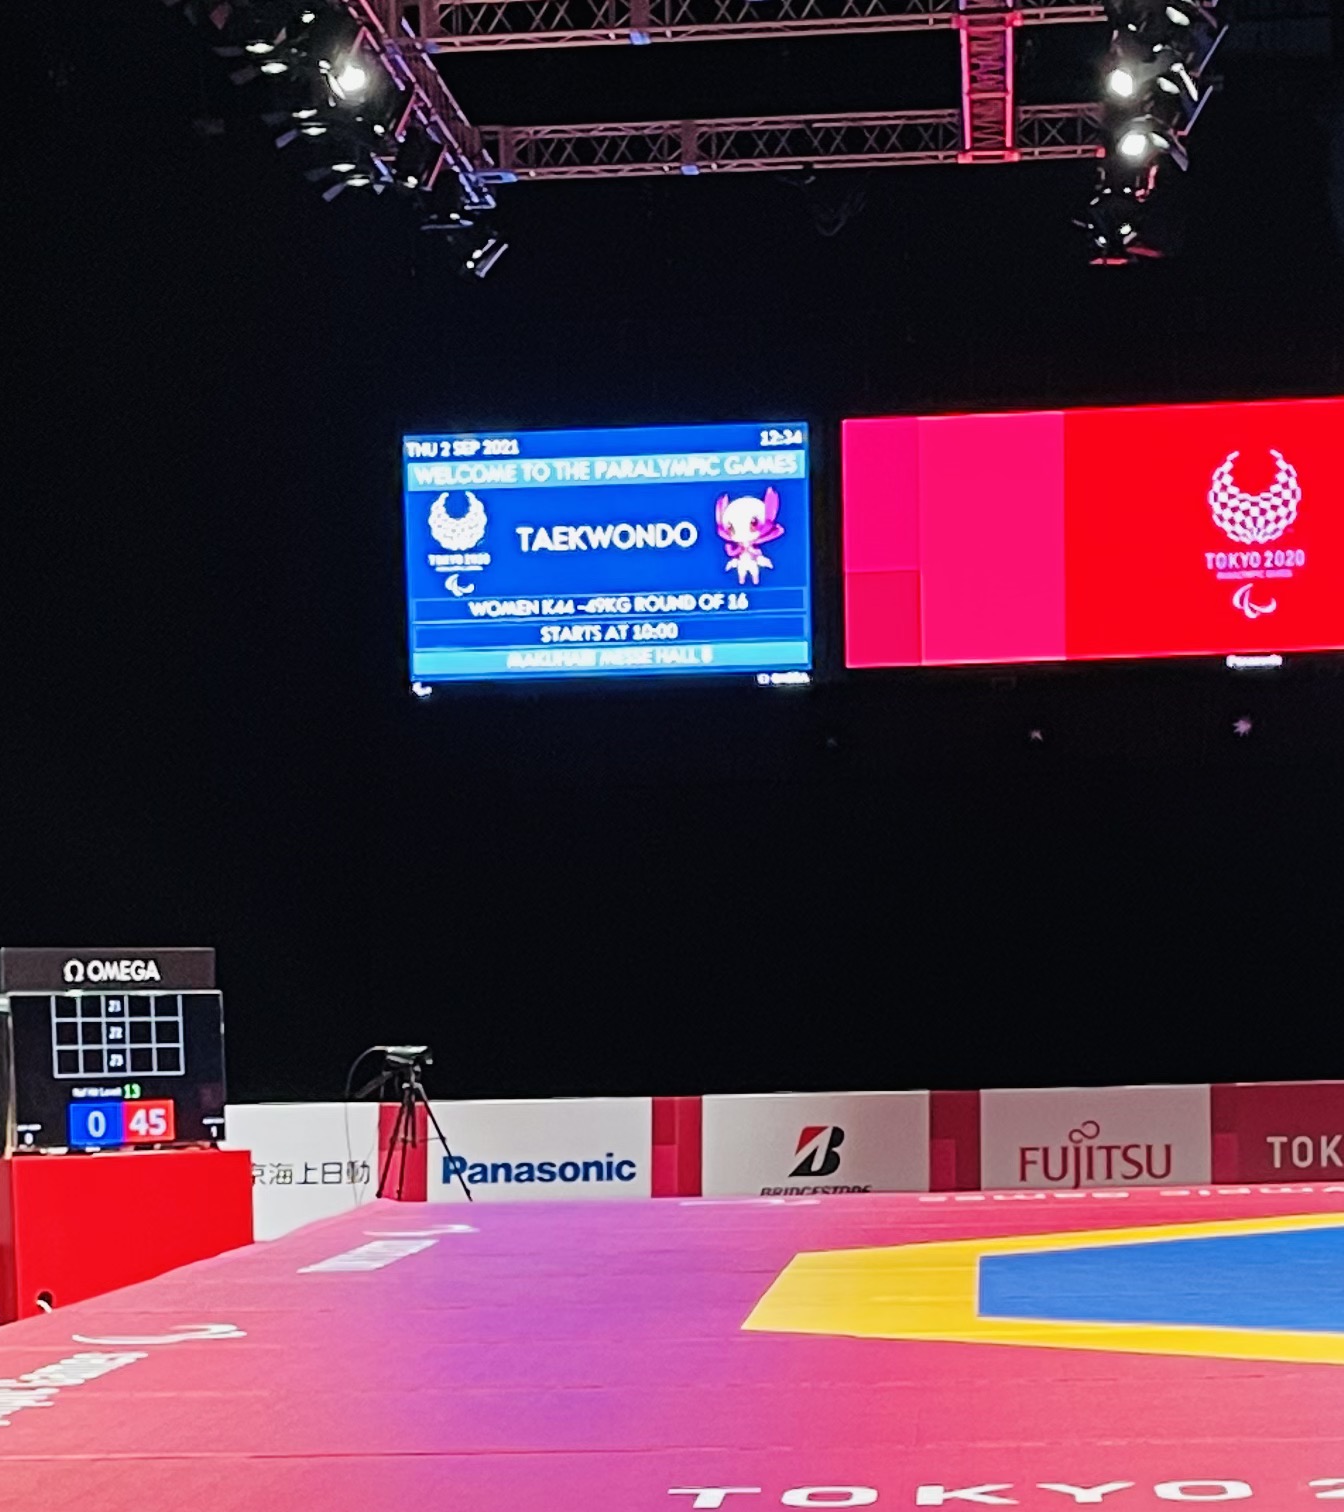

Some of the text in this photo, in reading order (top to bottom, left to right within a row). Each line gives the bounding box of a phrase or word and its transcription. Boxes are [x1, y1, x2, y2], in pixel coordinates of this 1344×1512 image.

[406, 438, 520, 457] THU 2 SEP 2021
[760, 429, 803, 447] 12:34
[414, 453, 798, 485] WELCOME TO THE PARALYMPIC GAMES
[516, 520, 698, 553] TAEKWONDO
[1205, 549, 1305, 570] TOKYO 2020
[468, 599, 539, 617] WOMEN
[542, 598, 575, 616] K44
[634, 594, 696, 612] ROUND
[698, 593, 725, 610] OF
[727, 592, 749, 610] 16
[540, 622, 679, 643] STARTS AT 10:00
[86, 959, 161, 983] OMEGA
[123, 1083, 142, 1099] 13
[87, 1108, 168, 1139] 0 45
[442, 1152, 637, 1185] Panasonic
[1019, 1143, 1173, 1189] FUJITSU
[668, 1478, 1254, 1509] TOKYO
